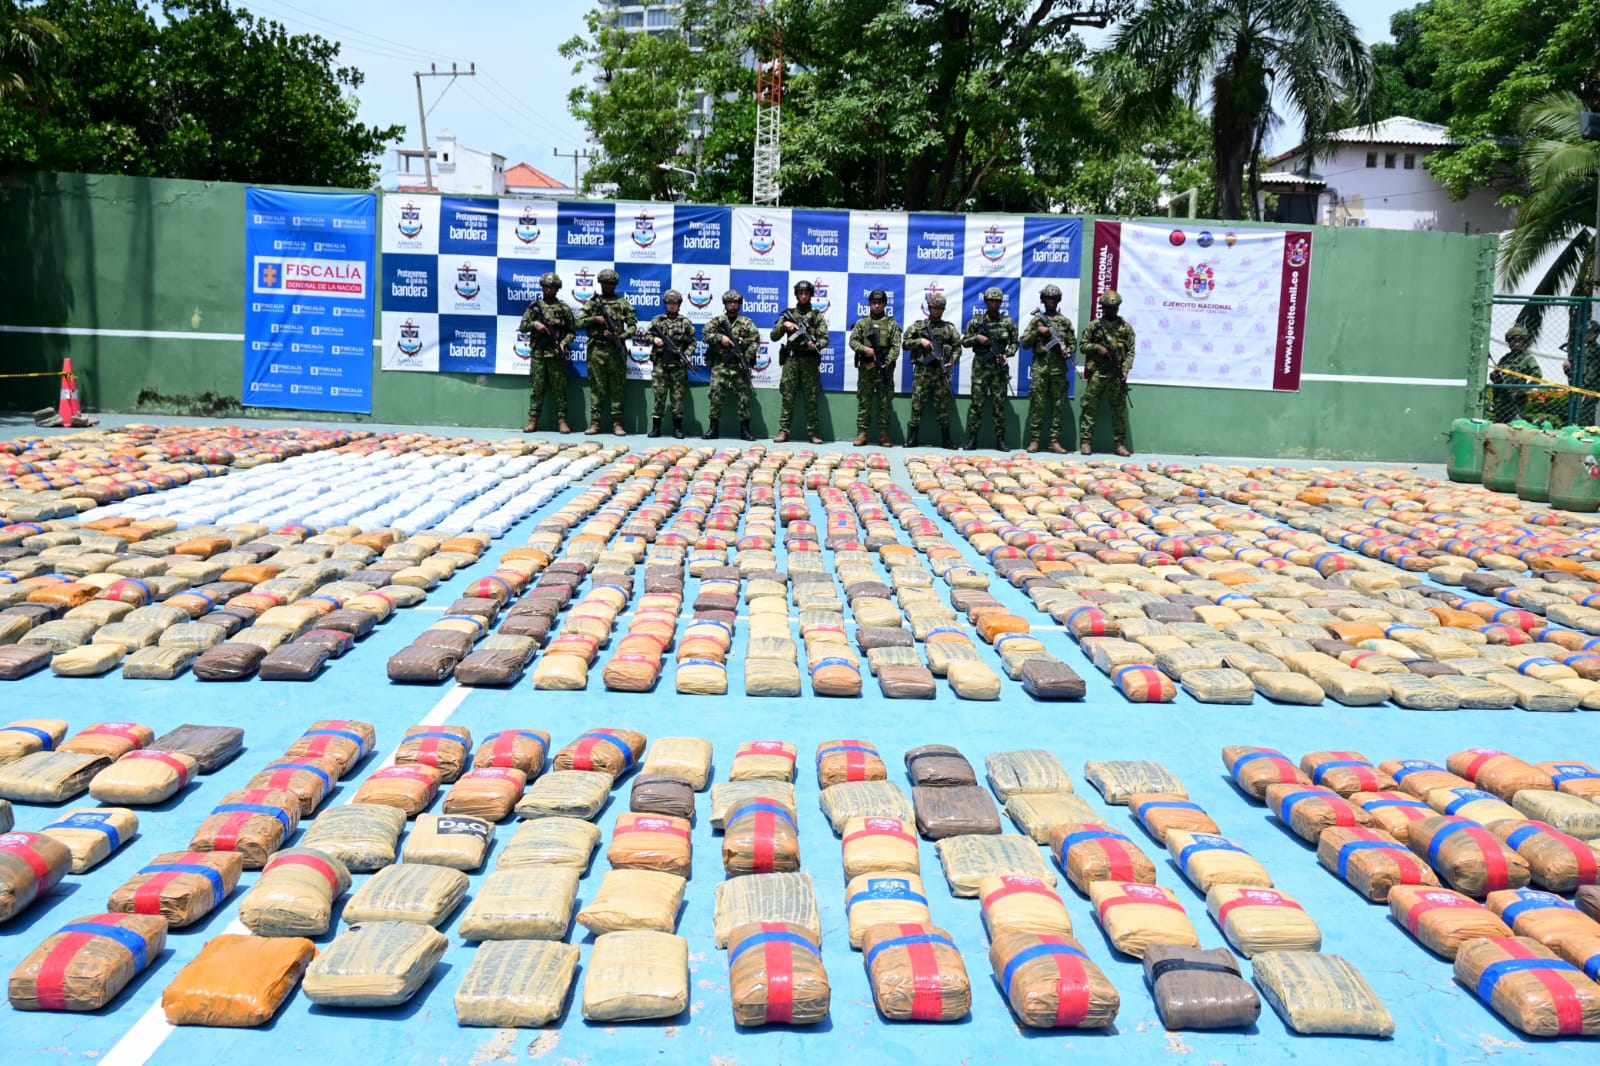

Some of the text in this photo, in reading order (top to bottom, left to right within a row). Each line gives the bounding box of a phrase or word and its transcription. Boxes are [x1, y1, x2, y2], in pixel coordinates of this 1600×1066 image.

[450, 224, 487, 240] bandera
[568, 230, 604, 246] bandera
[684, 233, 720, 249] bandera
[802, 242, 838, 256] bandera
[917, 245, 953, 260] bandera
[1032, 248, 1069, 263] bandera
[286, 264, 362, 279] FISCALÍA
[1097, 244, 1108, 294] NACIONAL
[1106, 253, 1114, 282] LEALTAD
[337, 284, 360, 292] NACIÓN
[392, 282, 428, 297] bandera
[742, 299, 778, 313] bandera
[1284, 271, 1299, 374] www.ejercito.mil.co
[450, 343, 486, 357] bandera
